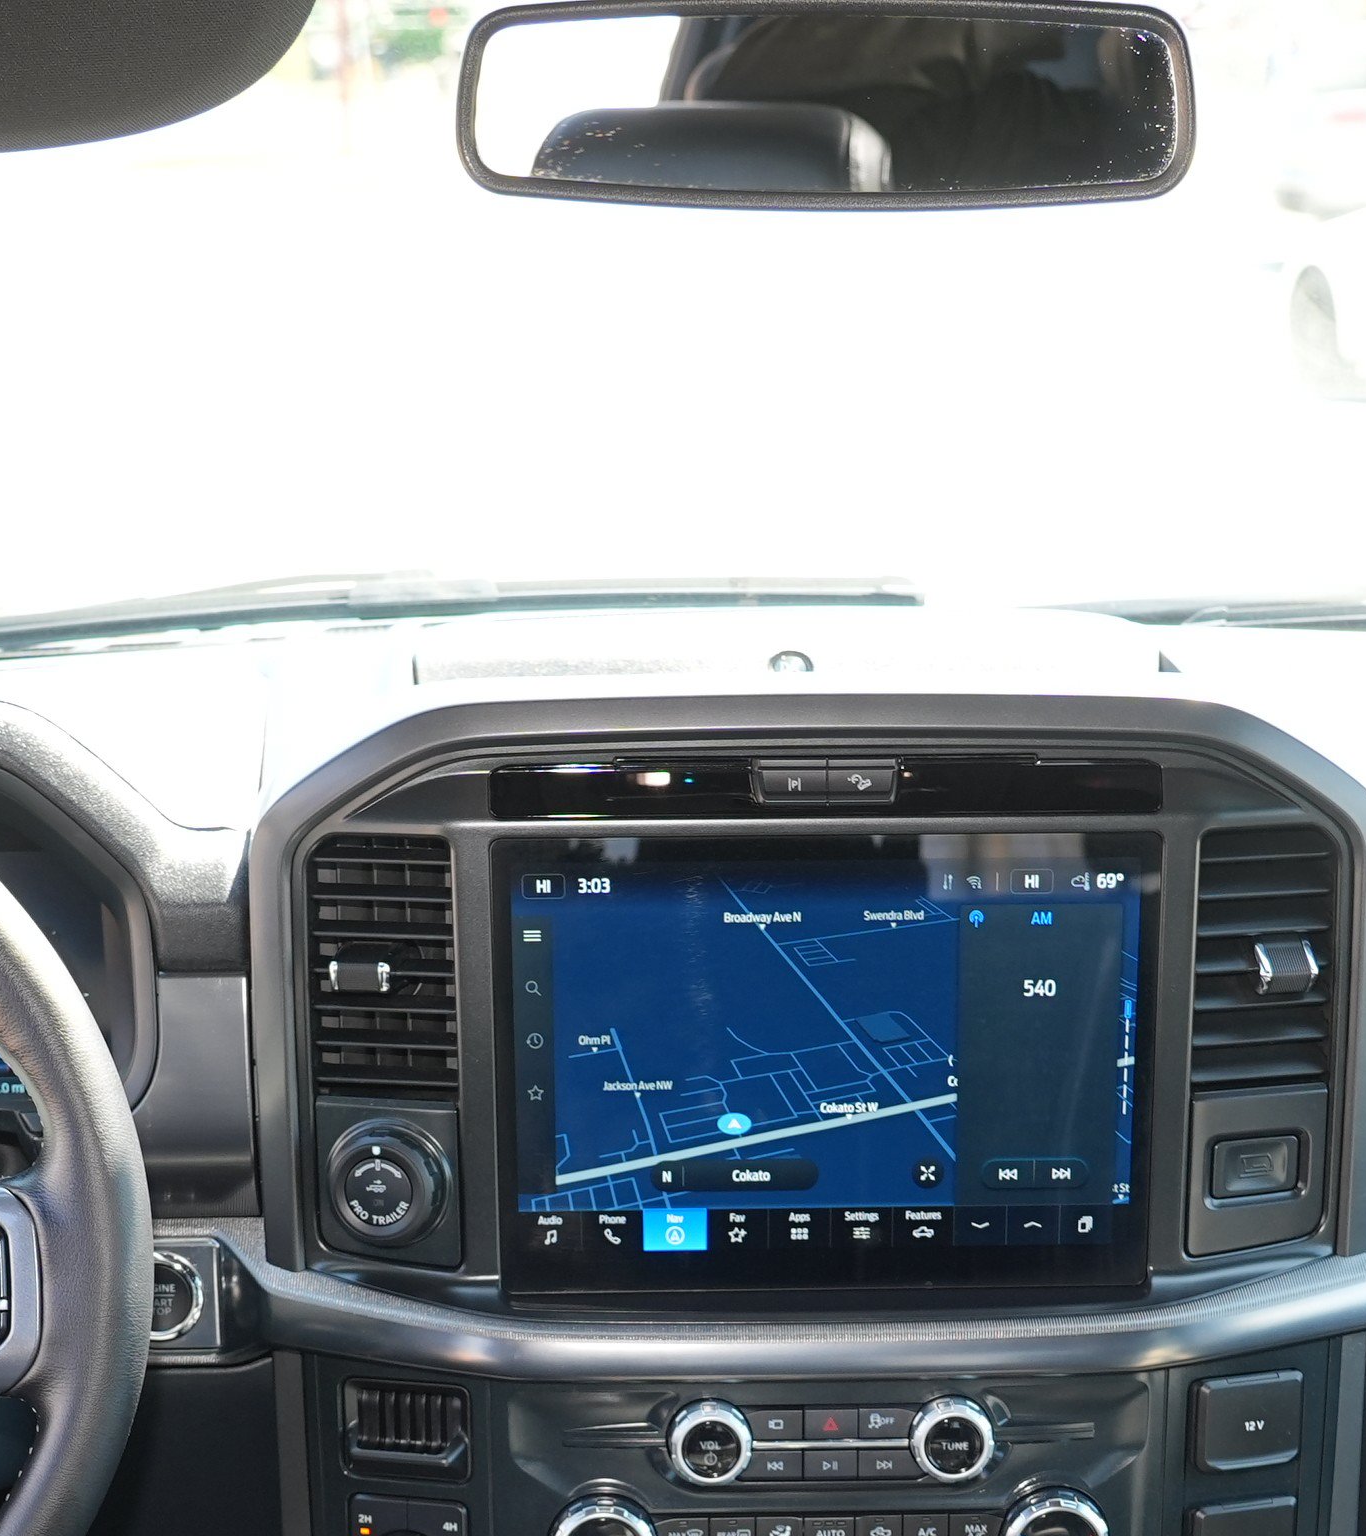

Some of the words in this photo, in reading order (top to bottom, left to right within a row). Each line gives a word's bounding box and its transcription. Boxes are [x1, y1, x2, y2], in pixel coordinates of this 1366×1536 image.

[535, 879, 551, 894] HI
[577, 877, 611, 894] 3:03
[1024, 875, 1039, 889] HI
[1096, 873, 1124, 889] 69°
[723, 912, 772, 925] Broadway
[773, 912, 793, 923] Ave
[793, 912, 802, 922] N
[863, 910, 903, 922] Swendra
[904, 910, 925, 921] Blvd
[1030, 911, 1052, 925] AM
[1023, 979, 1057, 997] 540
[578, 1035, 600, 1045] Ohm
[603, 1080, 637, 1091] Jackson
[638, 1081, 655, 1091] Ave
[656, 1080, 673, 1090] NW
[819, 1102, 854, 1113] Cokato
[855, 1102, 867, 1113] St
[867, 1102, 879, 1112] W
[662, 1171, 673, 1183] N
[732, 1169, 771, 1183] Cokato
[349, 1199, 369, 1220] PRO
[372, 1201, 409, 1225] TRAILER
[788, 1212, 811, 1223] Apps
[844, 1211, 880, 1222] Settings
[905, 1210, 942, 1221] Features
[537, 1215, 563, 1226] Audio
[598, 1214, 626, 1225] Phone
[666, 1214, 684, 1224] Nav
[729, 1213, 746, 1223] Fav
[881, 1417, 895, 1425] OFF
[1244, 1421, 1255, 1431] 12
[1256, 1420, 1265, 1430] V
[699, 1440, 721, 1450] VOL
[941, 1441, 969, 1451] TUNE
[358, 1514, 373, 1524] 2H
[442, 1522, 458, 1532] 4H
[917, 1528, 937, 1536] A/C
[965, 1524, 988, 1533] MAX
